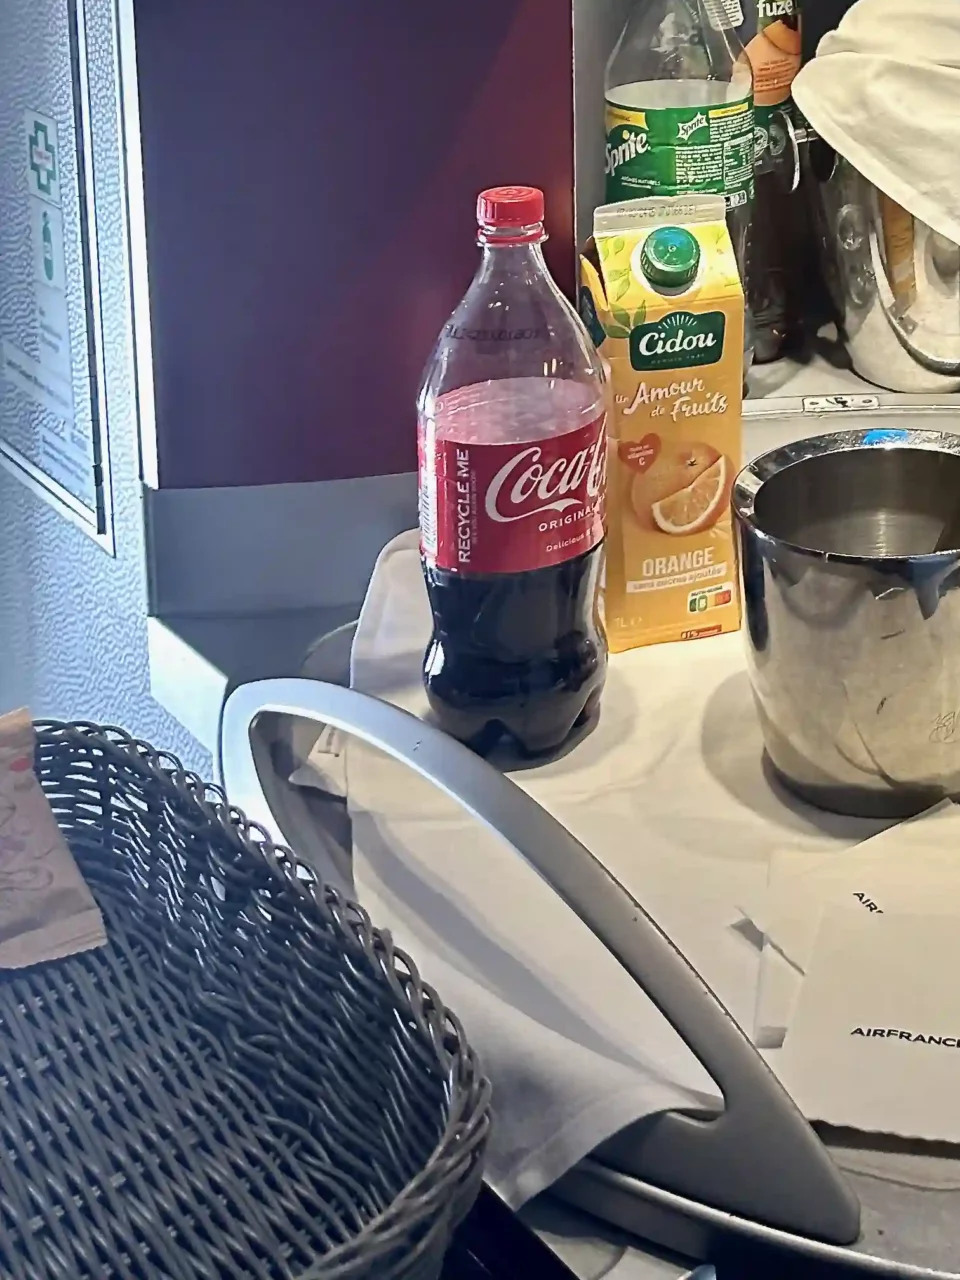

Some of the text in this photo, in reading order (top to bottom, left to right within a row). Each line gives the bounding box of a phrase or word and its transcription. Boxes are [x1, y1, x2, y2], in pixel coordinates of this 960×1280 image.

[680, 114, 705, 136] Sprite
[604, 129, 649, 177] Sprite
[638, 328, 717, 356] Cidou
[623, 377, 705, 415] Amour
[650, 391, 729, 422] de Fruits
[456, 448, 471, 563] RECYCLE ME
[546, 532, 586, 552] Delicious
[642, 546, 715, 577] ORANGE
